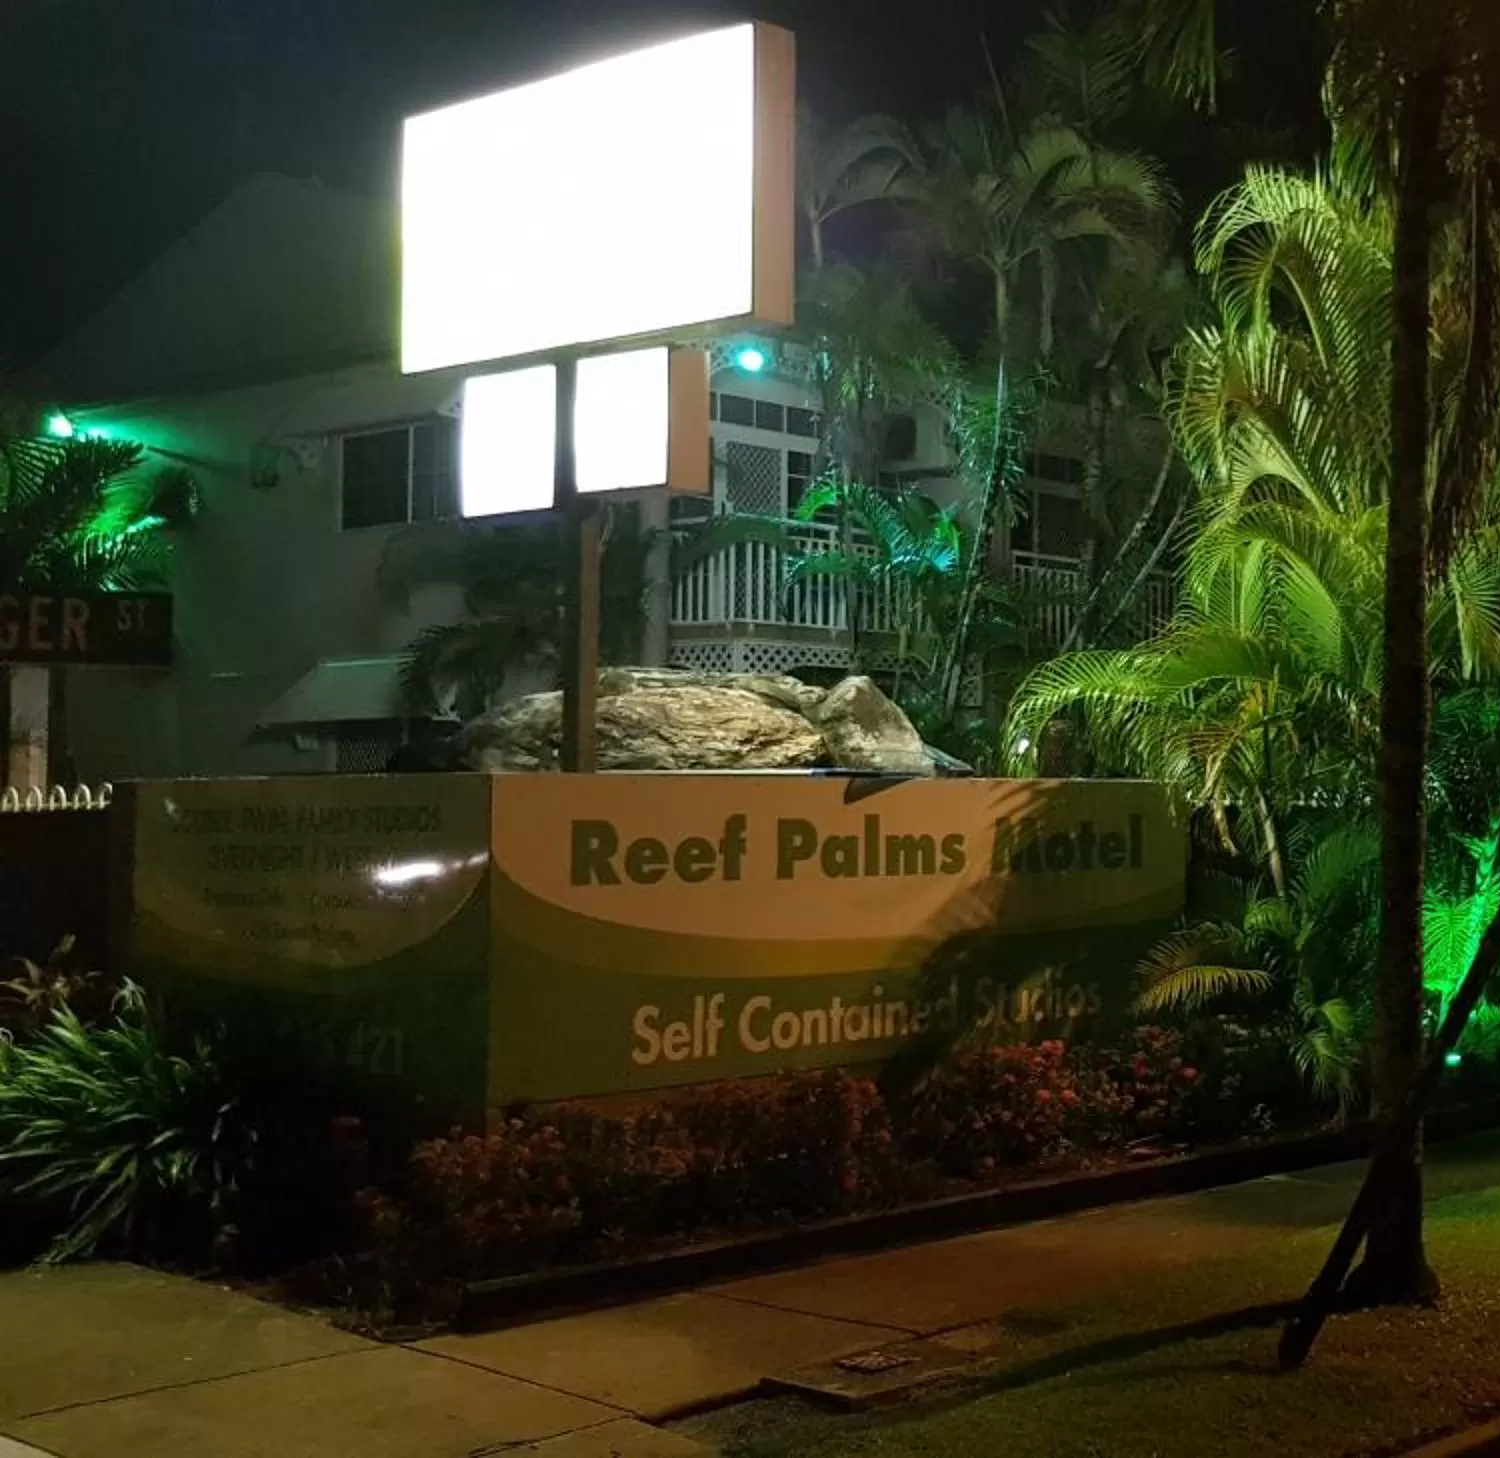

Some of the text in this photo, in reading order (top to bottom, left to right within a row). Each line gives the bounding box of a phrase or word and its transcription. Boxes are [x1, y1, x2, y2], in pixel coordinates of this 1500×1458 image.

[0, 594, 149, 652] GER ST
[571, 813, 1144, 886] Reef Palms Motel
[631, 991, 726, 1066] Self
[738, 974, 961, 1053] Contained
